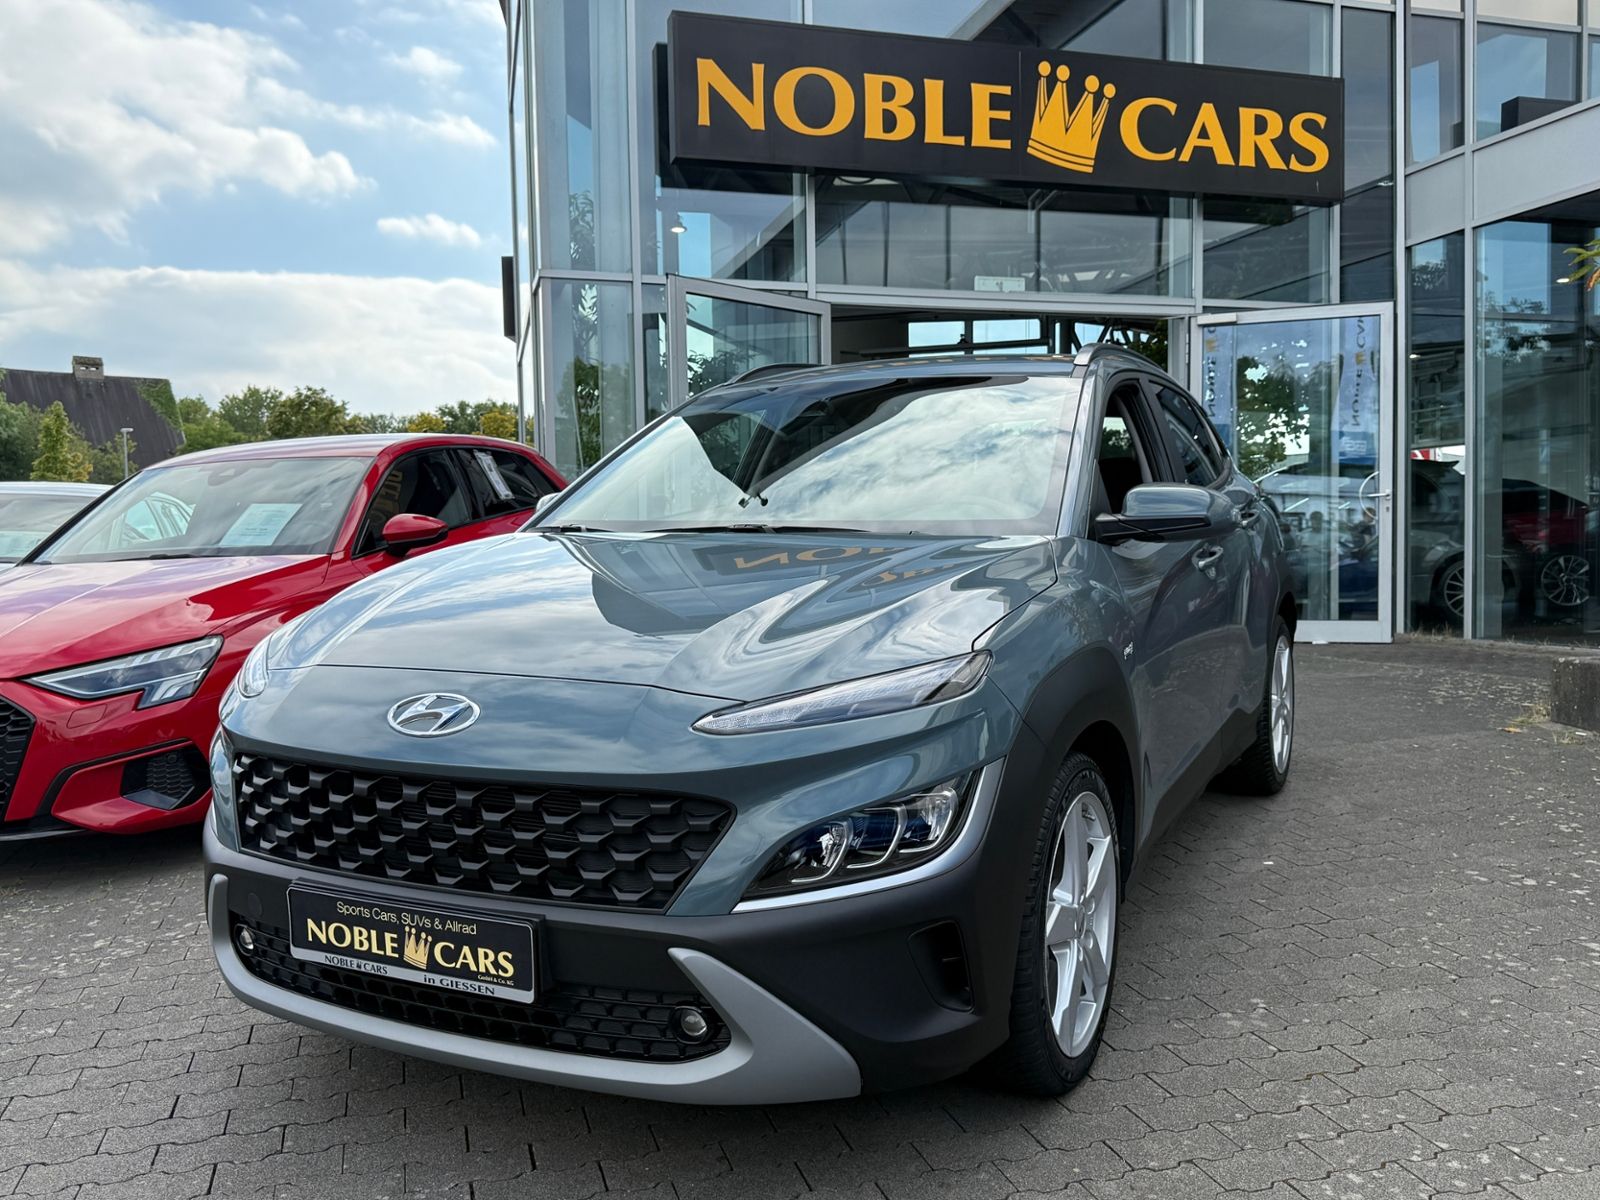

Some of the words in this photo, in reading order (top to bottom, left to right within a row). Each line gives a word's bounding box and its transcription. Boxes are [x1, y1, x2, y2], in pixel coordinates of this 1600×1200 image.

[696, 57, 1012, 149] NOBLE
[1119, 97, 1330, 173] CARS
[336, 901, 370, 919] Sports
[372, 907, 400, 925] Cars,
[401, 913, 432, 929] SUVs
[433, 918, 442, 930] &
[444, 920, 477, 935] Allrad
[306, 918, 399, 958] NOBLE
[434, 941, 515, 978] CARS
[324, 955, 355, 969] NOBLE
[363, 962, 388, 975] CARS
[423, 974, 435, 985] in
[439, 978, 495, 996] GIESSEN
